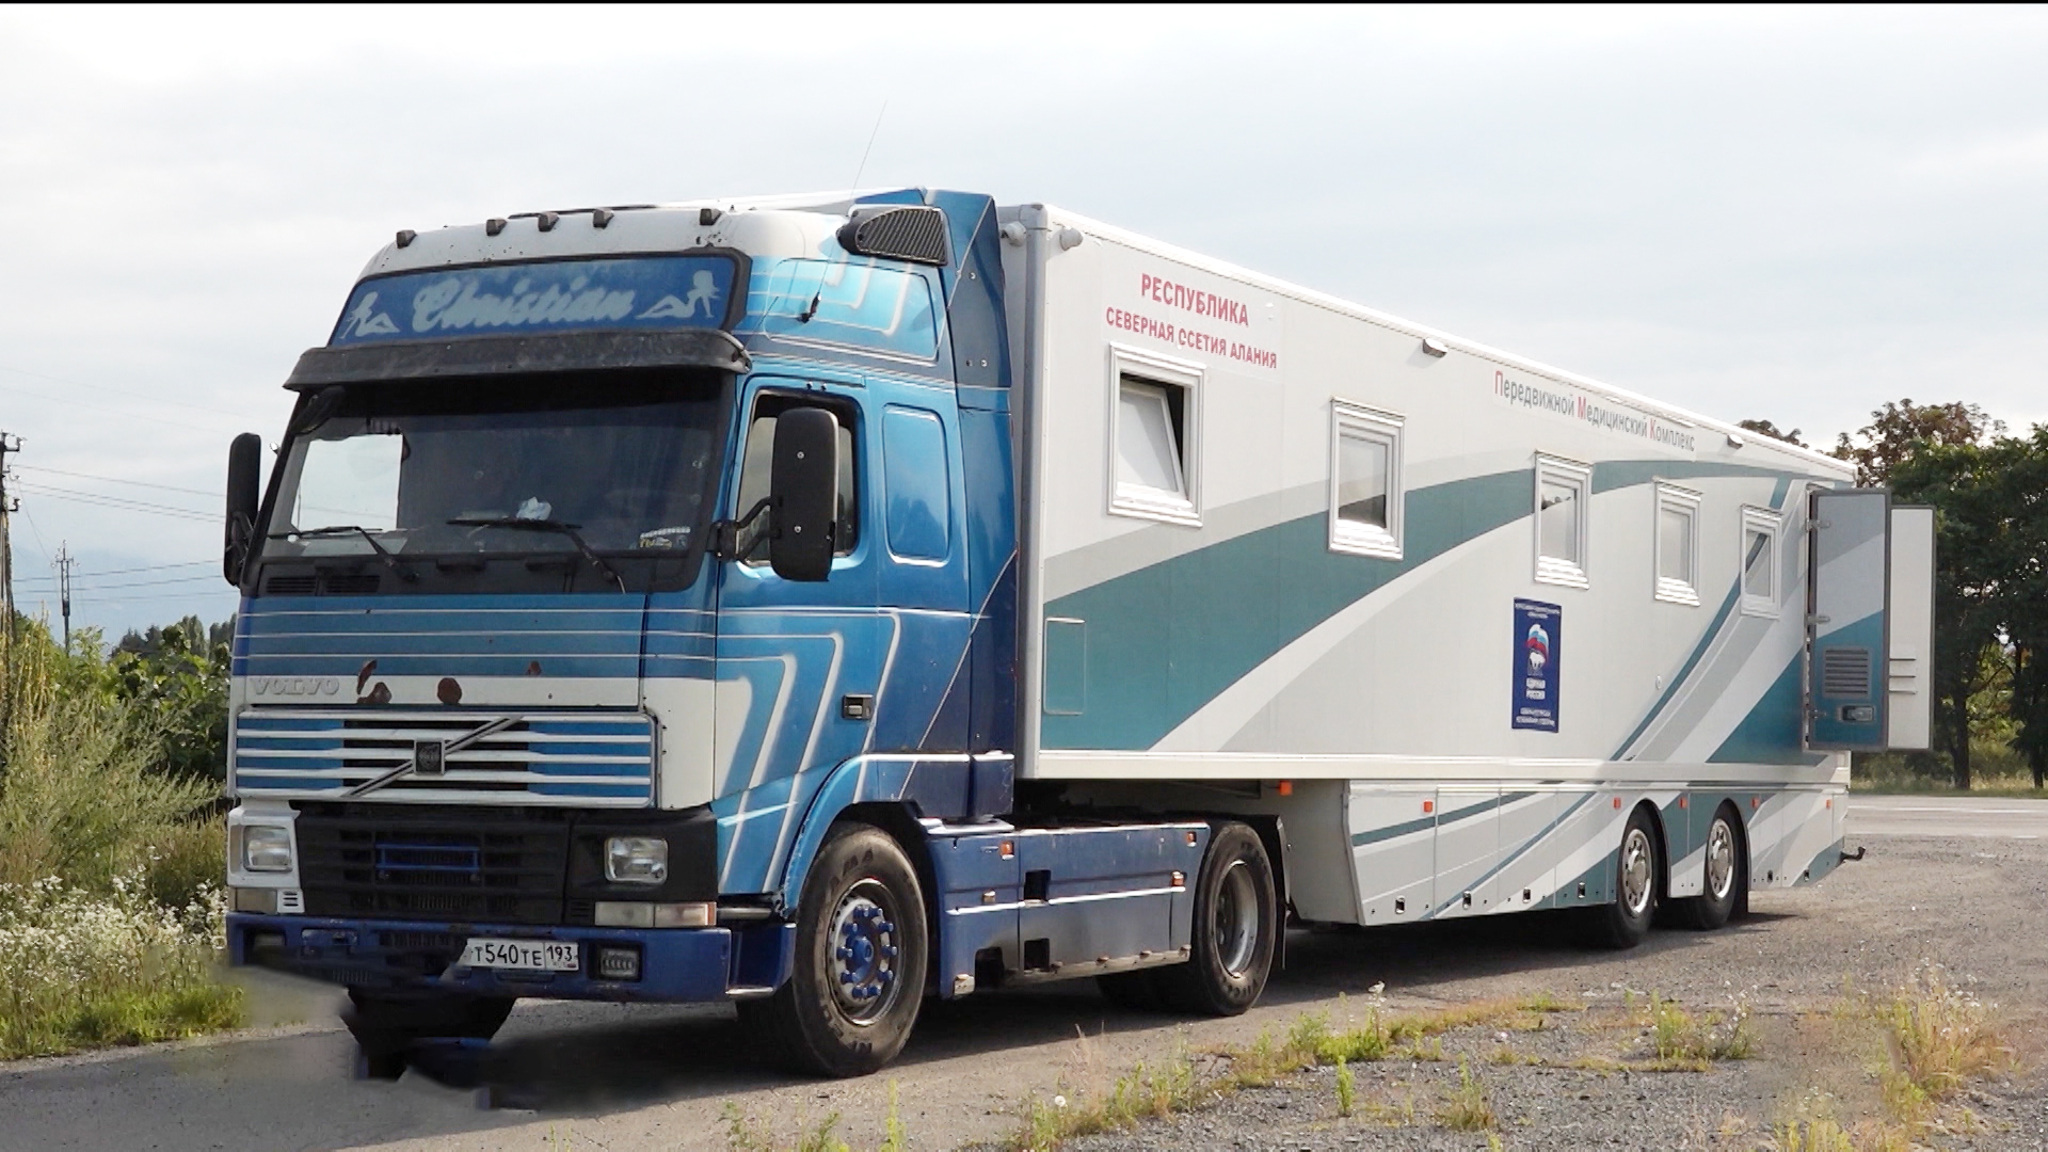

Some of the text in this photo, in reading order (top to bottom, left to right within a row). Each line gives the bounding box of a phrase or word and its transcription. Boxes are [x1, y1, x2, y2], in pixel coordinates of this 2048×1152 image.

[412, 276, 635, 333] Christian
[1141, 272, 1249, 327] РЕСПУБЛИКА
[1106, 306, 1174, 343] СЕВЕРНАЯ
[1230, 342, 1277, 369] АЛАНИЯ
[1494, 370, 1695, 452] Передвижной Медицинский Комплекс
[254, 677, 340, 696] VOLVO
